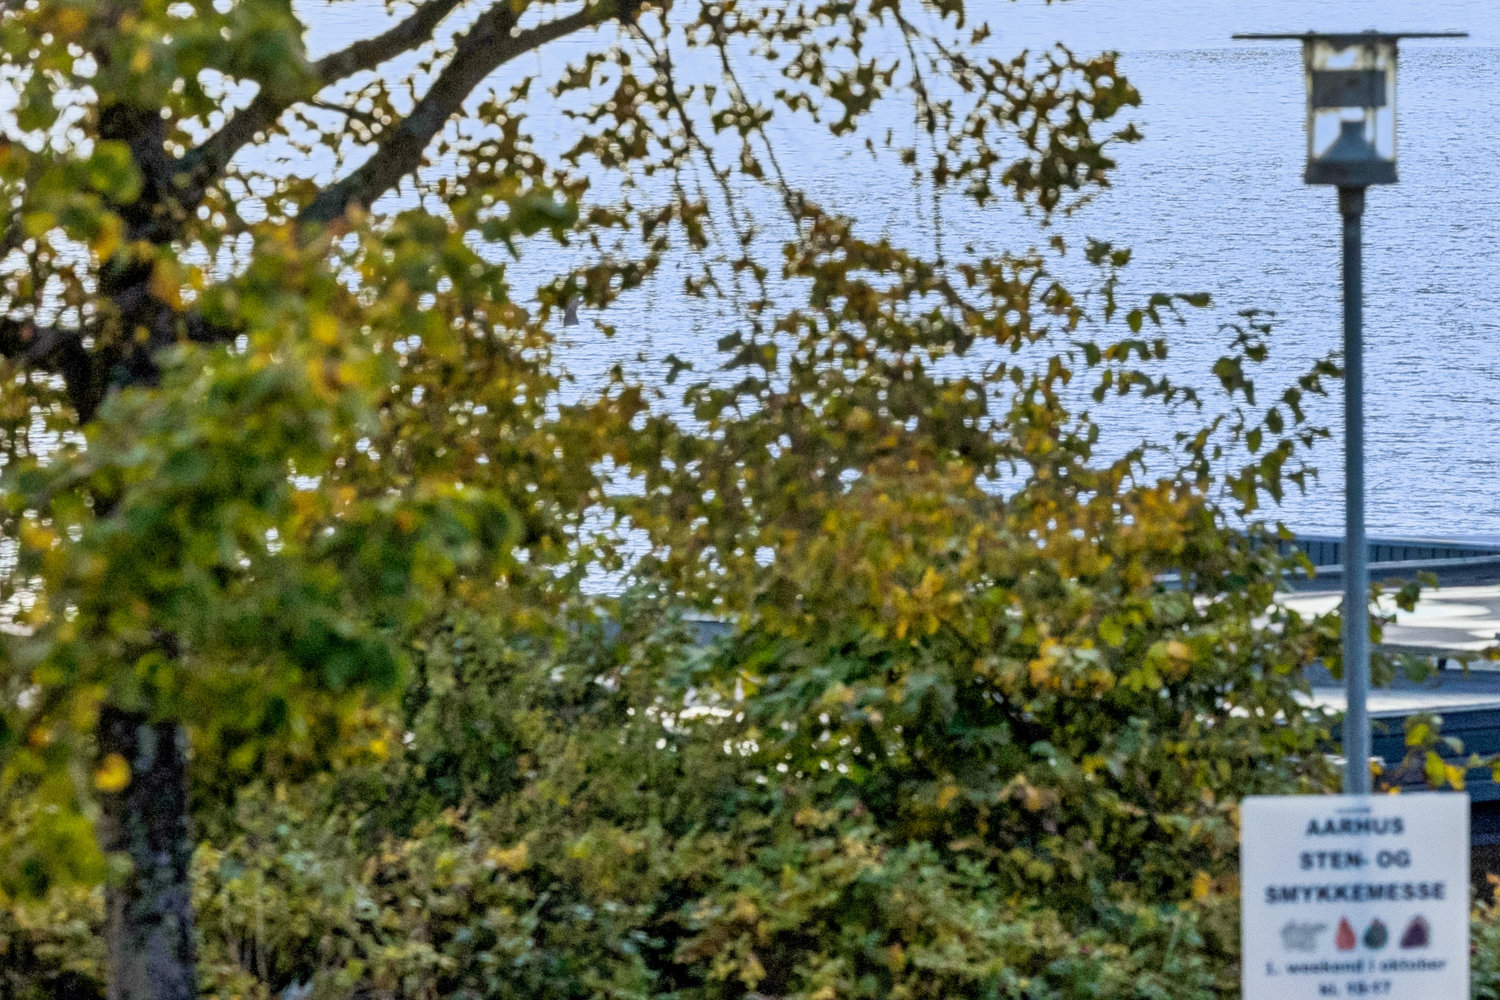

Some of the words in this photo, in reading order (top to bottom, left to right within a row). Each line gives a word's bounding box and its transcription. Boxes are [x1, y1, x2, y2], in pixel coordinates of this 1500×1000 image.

[1306, 818, 1405, 836] AARHUS
[1376, 850, 1411, 869] OG
[1265, 881, 1445, 903] SMYKKEMESSE
[1286, 960, 1364, 975] weekend
[1378, 959, 1447, 973] oktober
